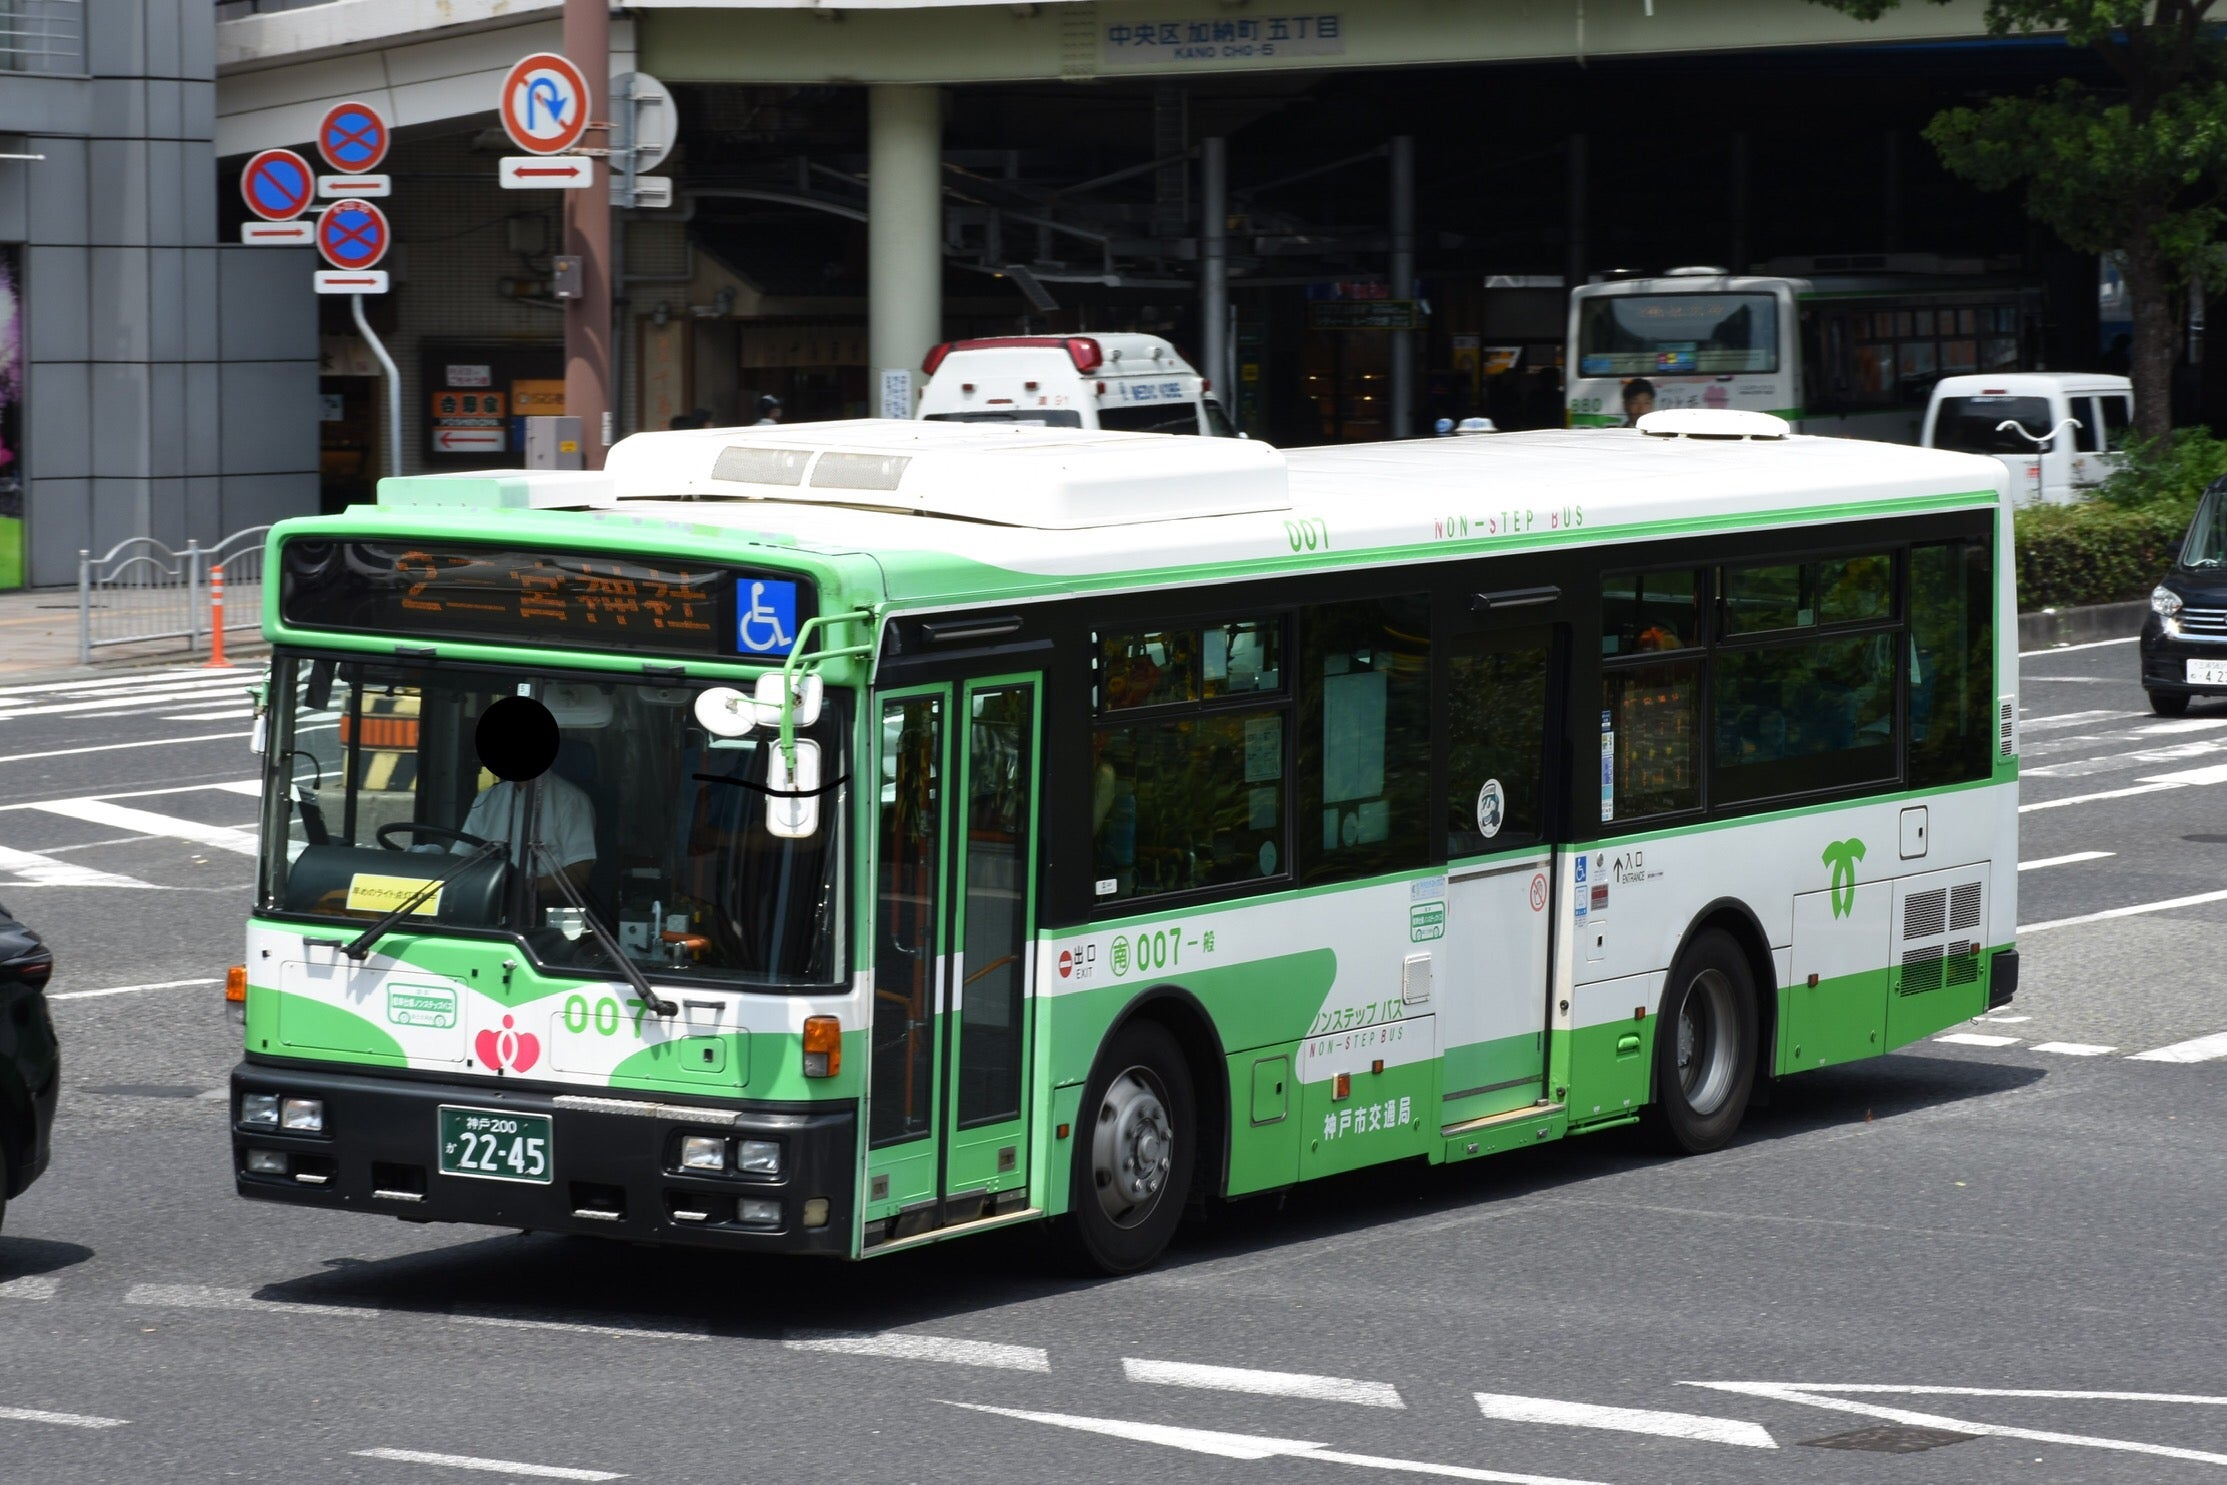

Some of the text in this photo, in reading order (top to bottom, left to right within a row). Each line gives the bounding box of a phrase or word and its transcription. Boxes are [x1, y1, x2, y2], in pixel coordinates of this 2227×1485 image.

[1174, 44, 1274, 59] KANO CHO-5
[1551, 505, 1584, 529] BUS
[1284, 518, 1329, 552] 007
[396, 550, 443, 611] 2
[1625, 851, 1643, 870] 入口
[1622, 871, 1645, 884] ENTRANCE
[1074, 944, 1096, 965] 出口
[1137, 927, 1182, 971] 007
[1076, 966, 1093, 979] EXIT
[565, 994, 648, 1038] 007
[1309, 1026, 1403, 1058] NON-STEP BUS
[1323, 1096, 1411, 1141] 神戸市交通局
[460, 1132, 545, 1175] 22-45
